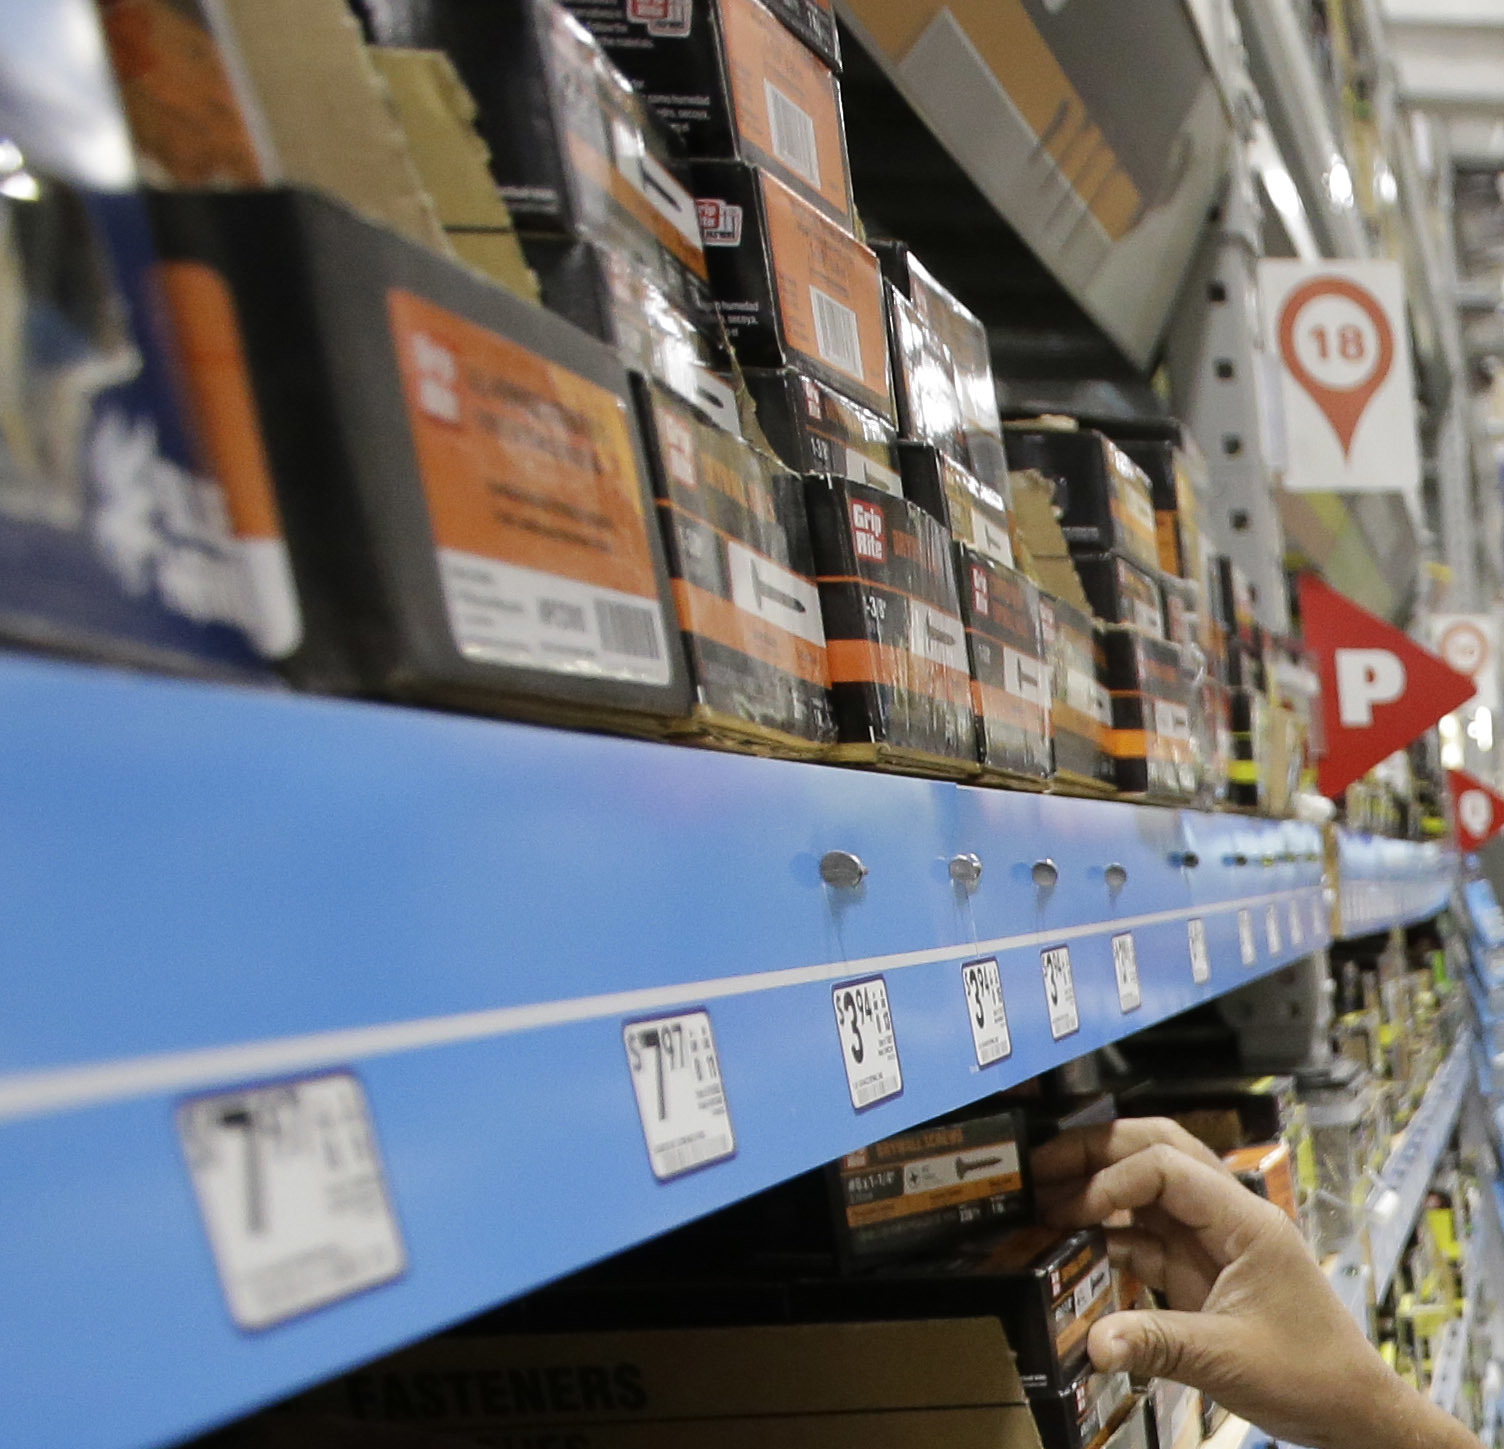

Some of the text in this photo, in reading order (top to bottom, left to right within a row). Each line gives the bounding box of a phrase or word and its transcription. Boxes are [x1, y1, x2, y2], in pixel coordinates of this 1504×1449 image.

[1306, 324, 1365, 363] 18
[852, 503, 883, 534] Grip
[855, 532, 884, 560] Rite
[1335, 648, 1406, 728] P
[342, 1362, 648, 1420] FASTENERS
